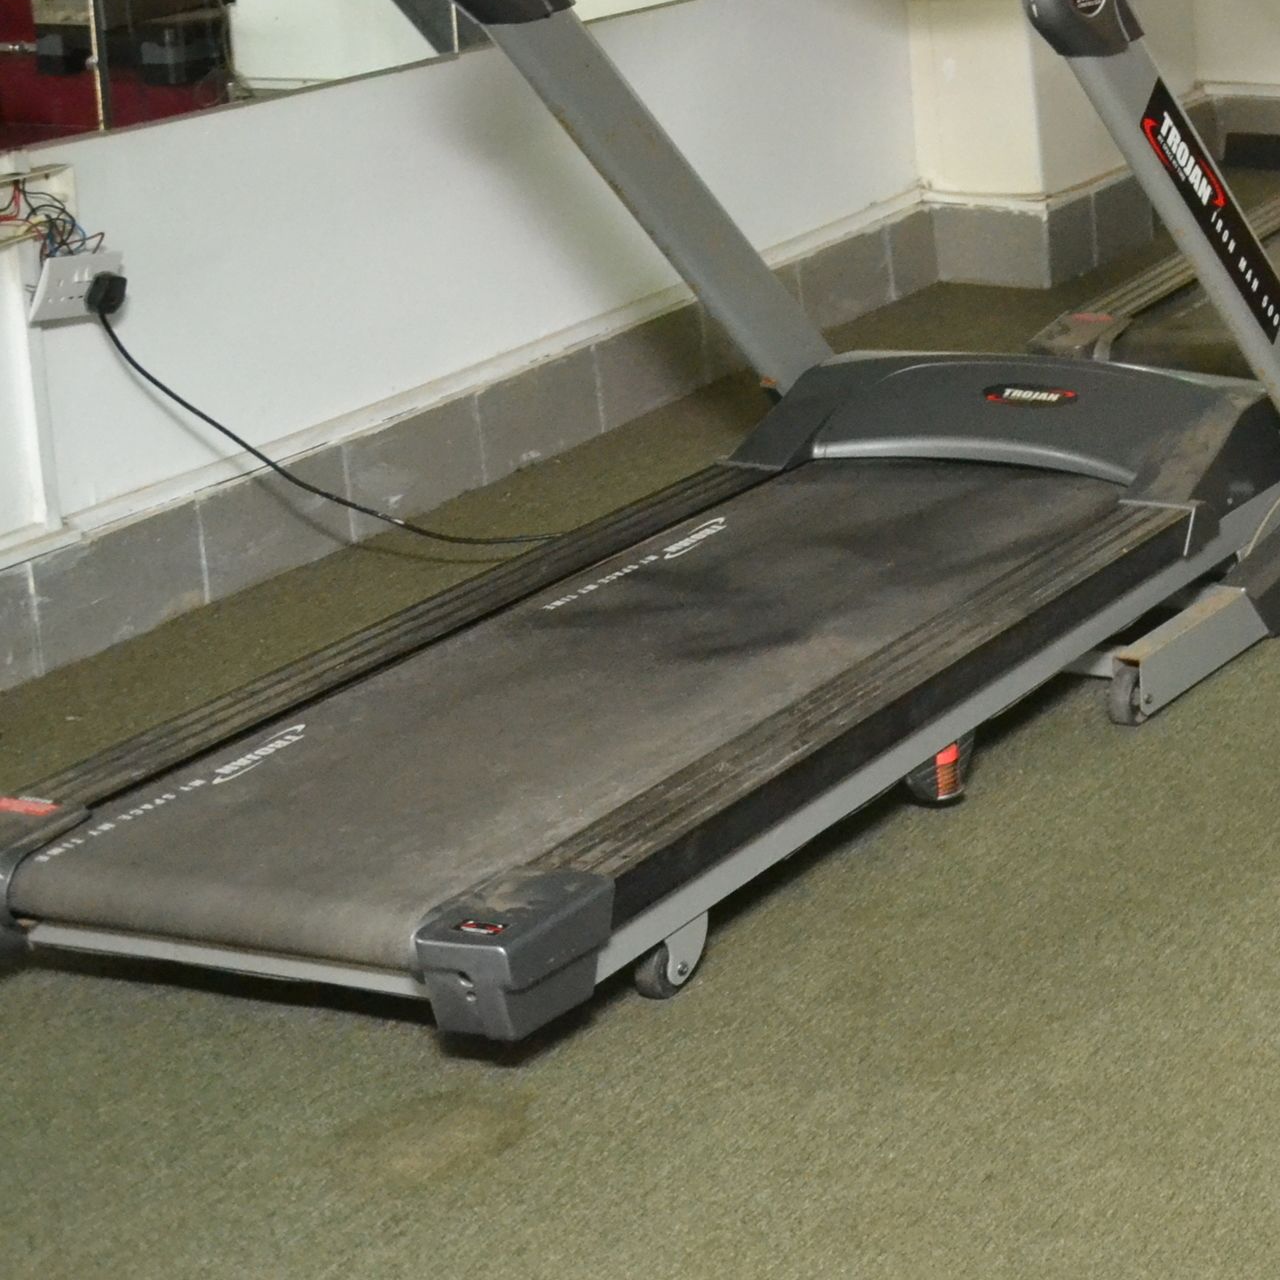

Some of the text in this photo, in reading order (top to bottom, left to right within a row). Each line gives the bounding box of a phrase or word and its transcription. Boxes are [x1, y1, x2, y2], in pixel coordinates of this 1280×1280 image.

[1160, 111, 1212, 206] TROJAN
[1211, 211, 1280, 326] IRON MAN 500
[1002, 388, 1061, 402] TROJAN
[215, 734, 305, 774] TROJAN
